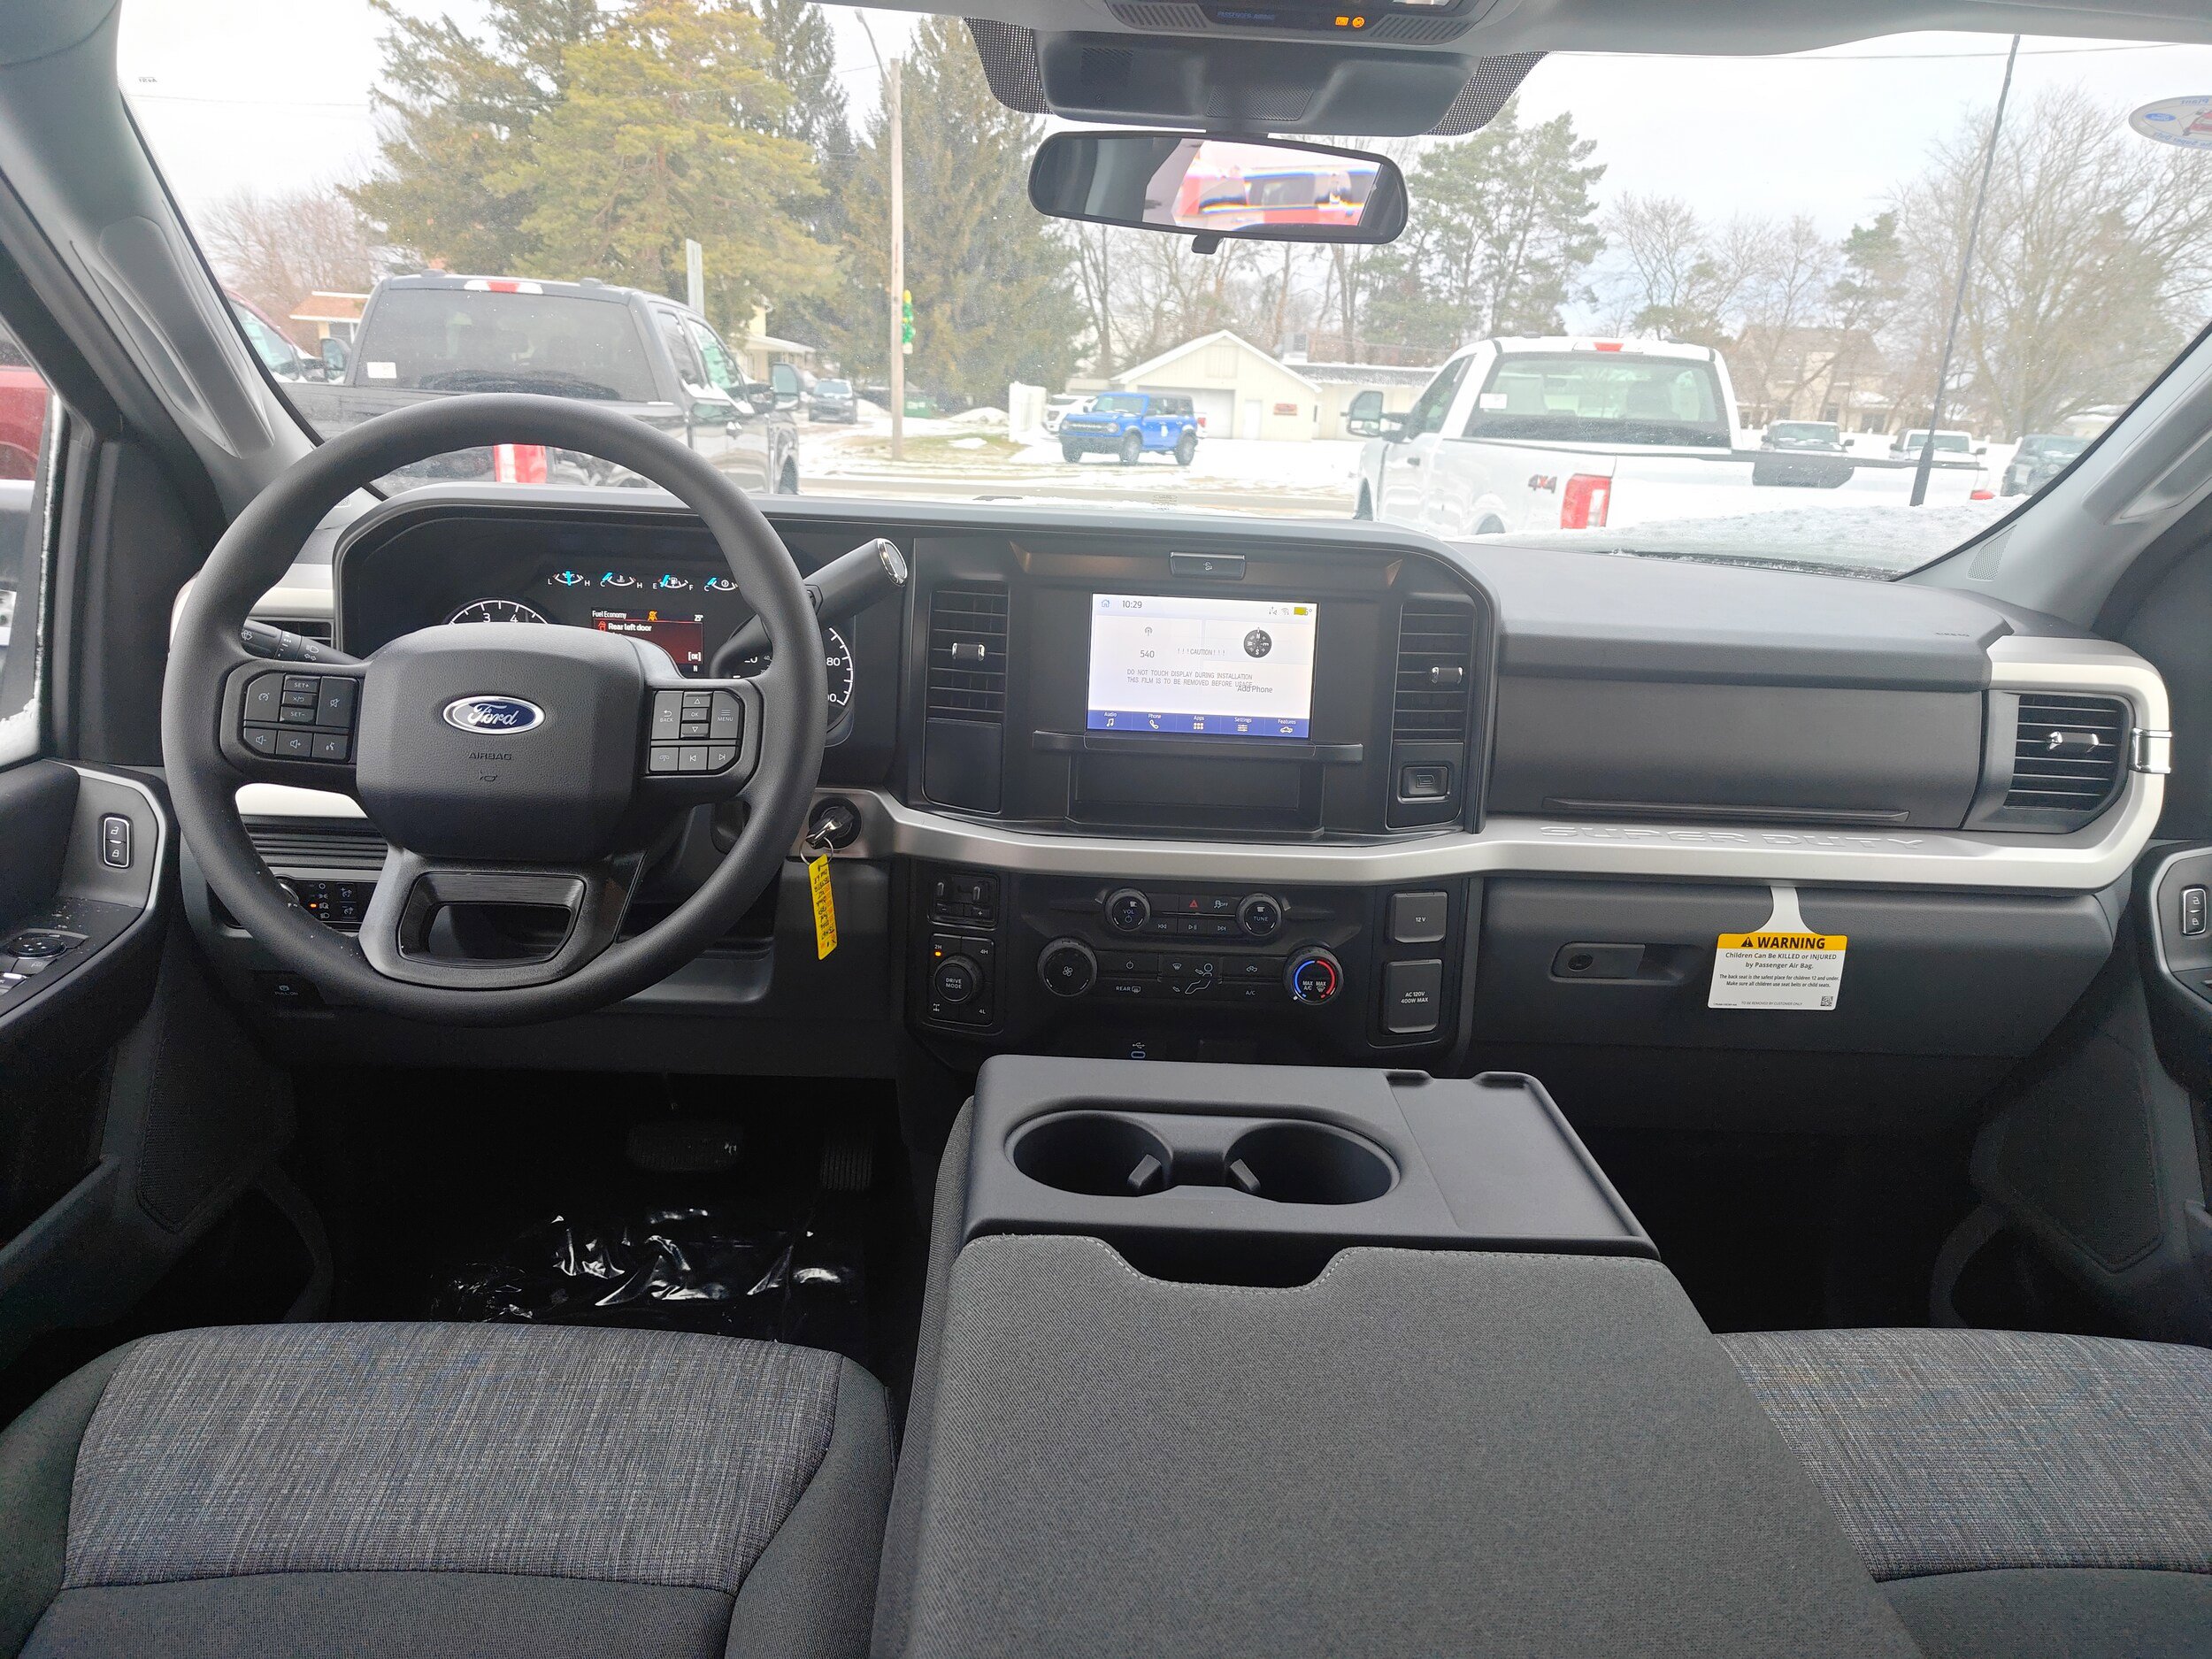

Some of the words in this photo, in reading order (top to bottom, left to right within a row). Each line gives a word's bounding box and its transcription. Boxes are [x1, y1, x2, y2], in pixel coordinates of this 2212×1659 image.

[1122, 599, 1142, 609] 10:29
[483, 613, 490, 623] 3
[510, 614, 518, 623] 4
[604, 611, 626, 619] Economy
[826, 657, 841, 666] 80
[468, 703, 519, 726] Ford
[468, 752, 512, 761] AIRBAG
[1540, 826, 1749, 843] SUPER
[1762, 833, 1924, 850] DUTY
[1757, 937, 1825, 949] WARNING
